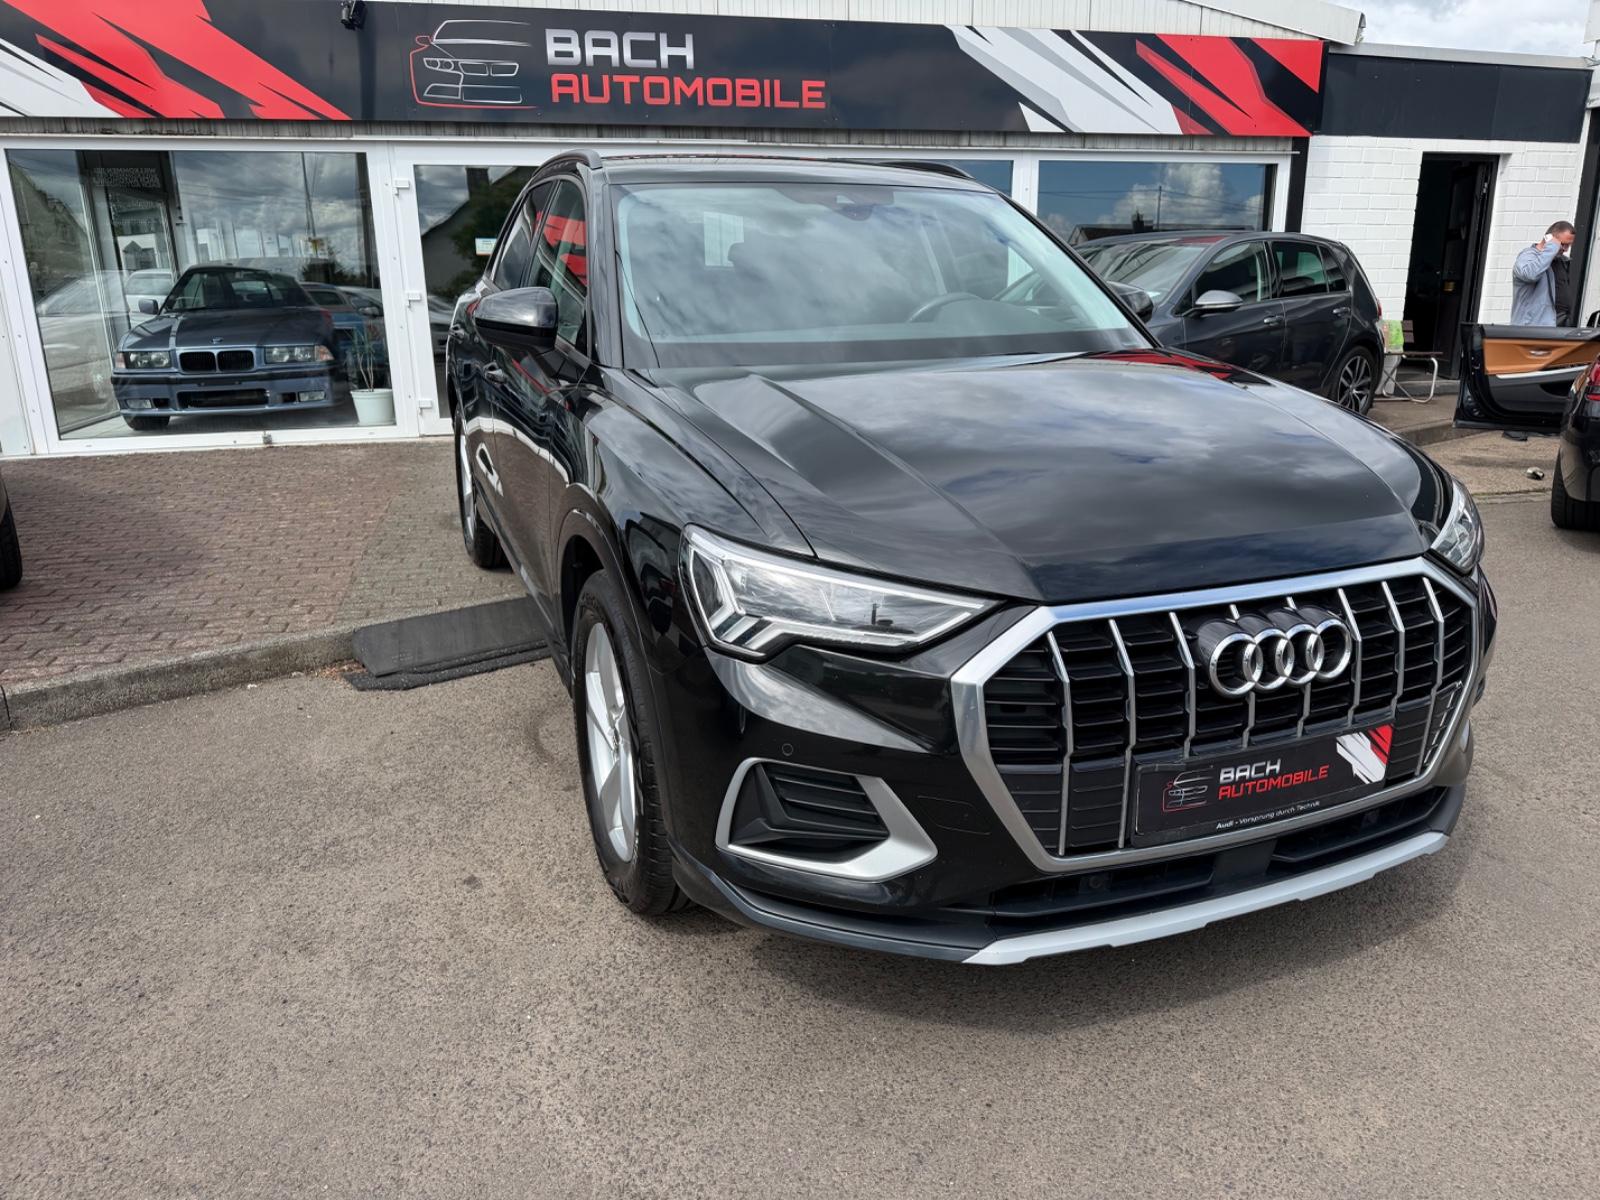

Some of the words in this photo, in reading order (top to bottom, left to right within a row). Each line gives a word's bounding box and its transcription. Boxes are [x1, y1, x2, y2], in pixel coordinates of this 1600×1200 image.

[545, 28, 694, 69] BACH
[551, 73, 826, 109] AUTOMOBILE
[1218, 764, 1330, 800] AUTOMOBILE
[1219, 758, 1281, 784] BACH
[1216, 820, 1234, 830] Audi
[1239, 812, 1275, 825] Vorsprung
[1275, 807, 1295, 816] durch
[1296, 801, 1320, 812] Technik
